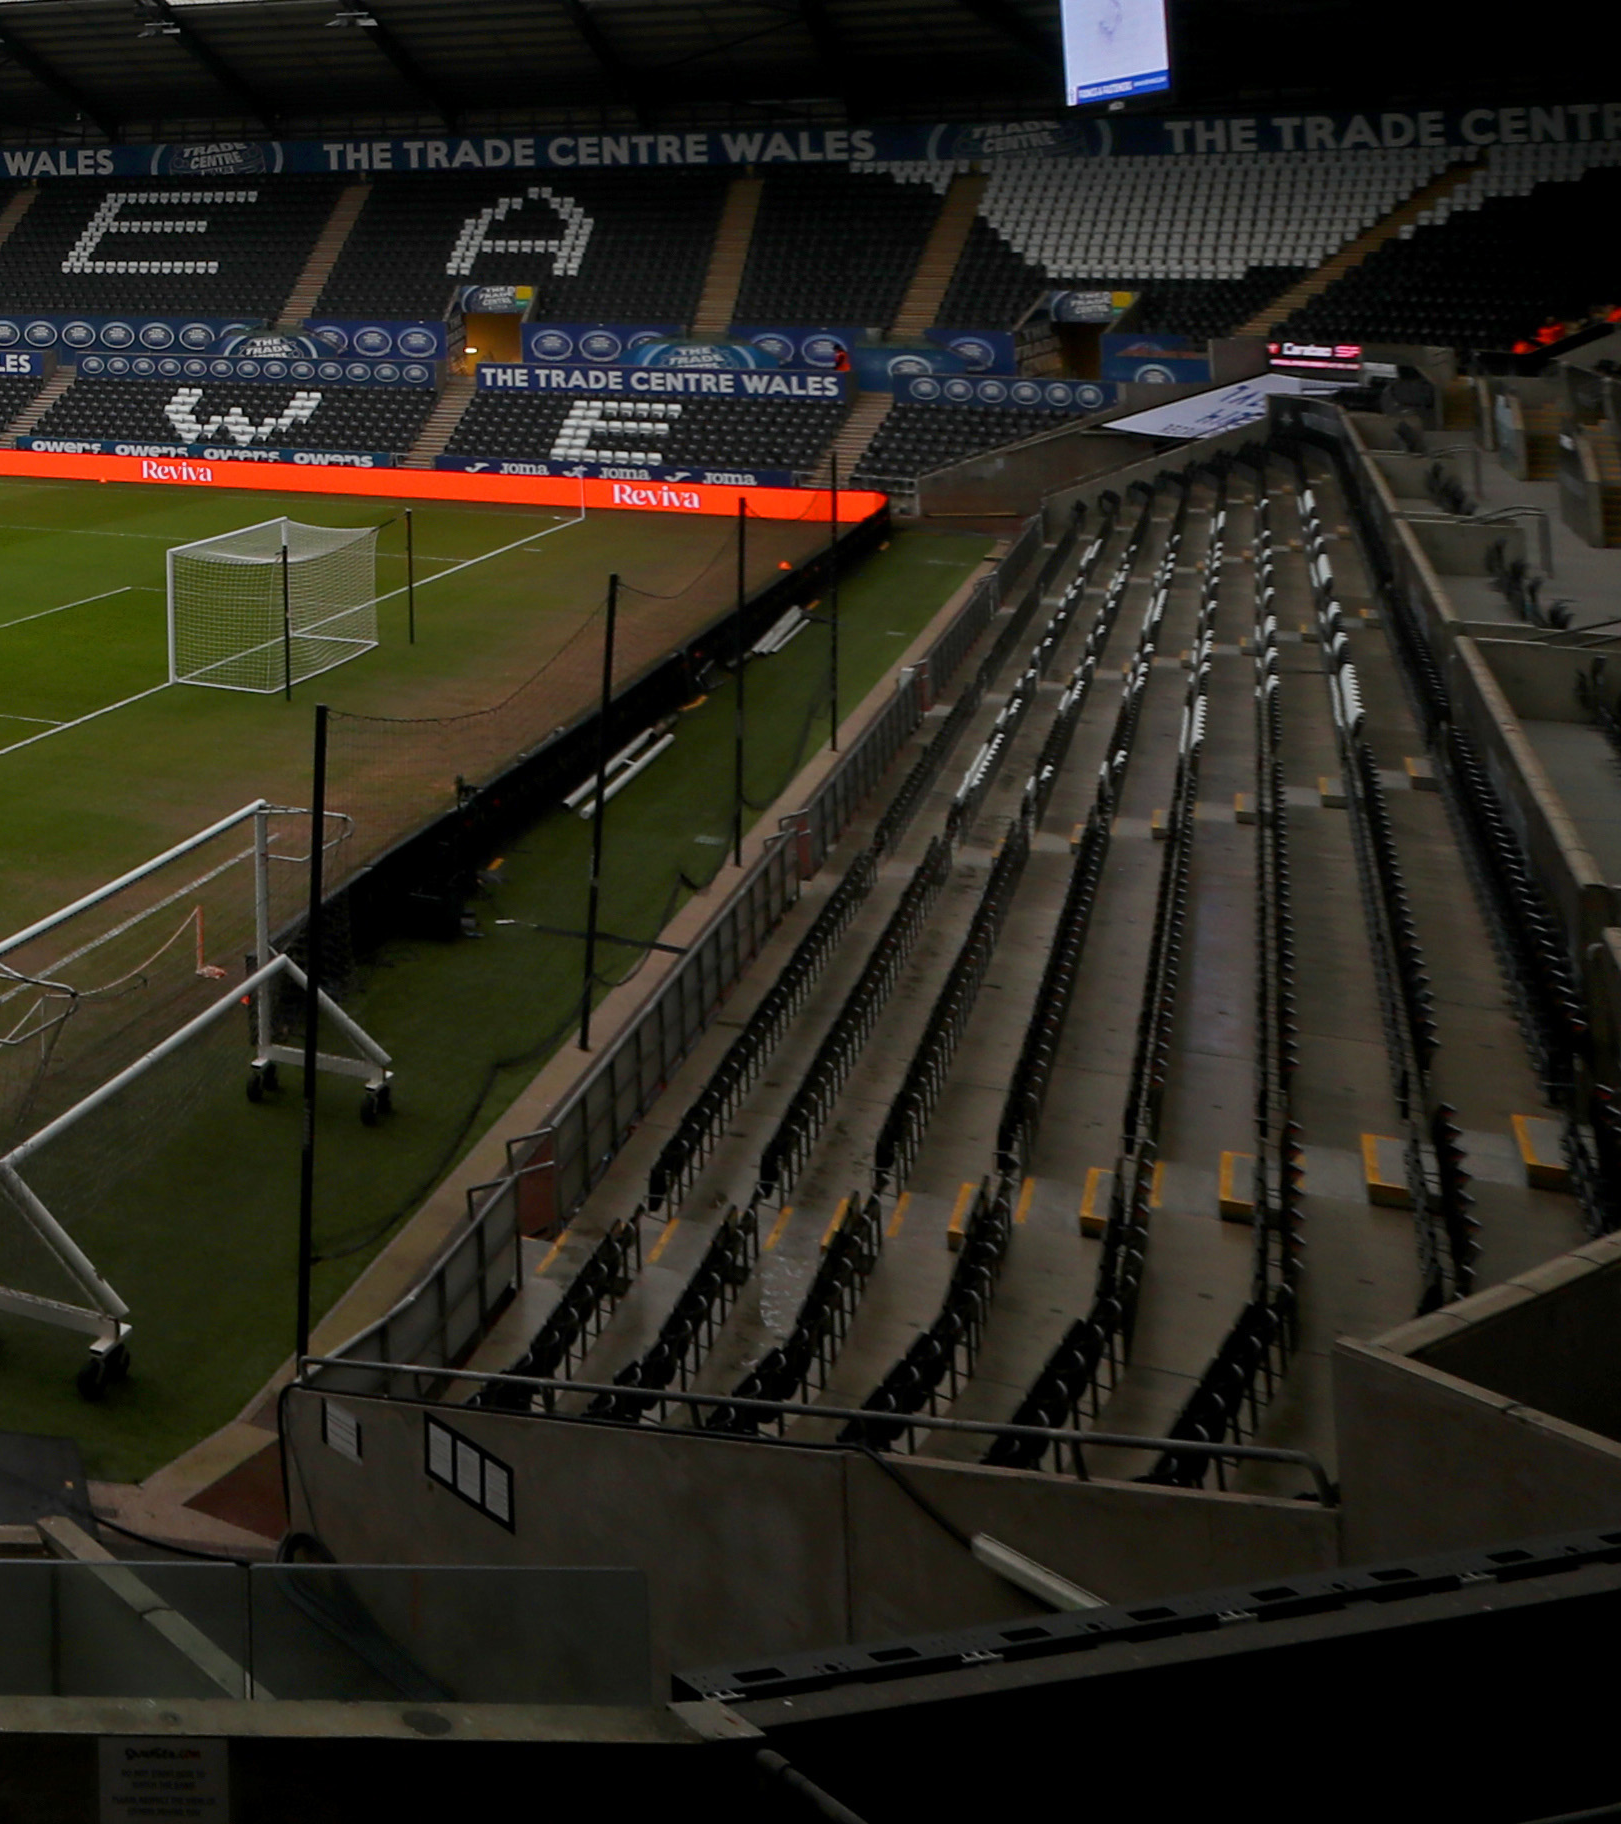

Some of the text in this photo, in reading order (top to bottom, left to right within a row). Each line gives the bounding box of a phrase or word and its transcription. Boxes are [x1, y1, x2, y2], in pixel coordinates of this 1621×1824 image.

[1164, 119, 1257, 154] THE
[1271, 111, 1447, 151] TRADE
[190, 151, 244, 169] CENTRE
[323, 129, 876, 170] THE TRADE CENTRE WALES
[4, 149, 114, 175] WALES
[254, 338, 283, 346] THE
[679, 347, 712, 355] THE
[481, 367, 839, 397] THE TRADE CENTRE WALES
[141, 459, 213, 482] Reviva
[293, 451, 374, 468] owens
[613, 483, 701, 509] Reviva
